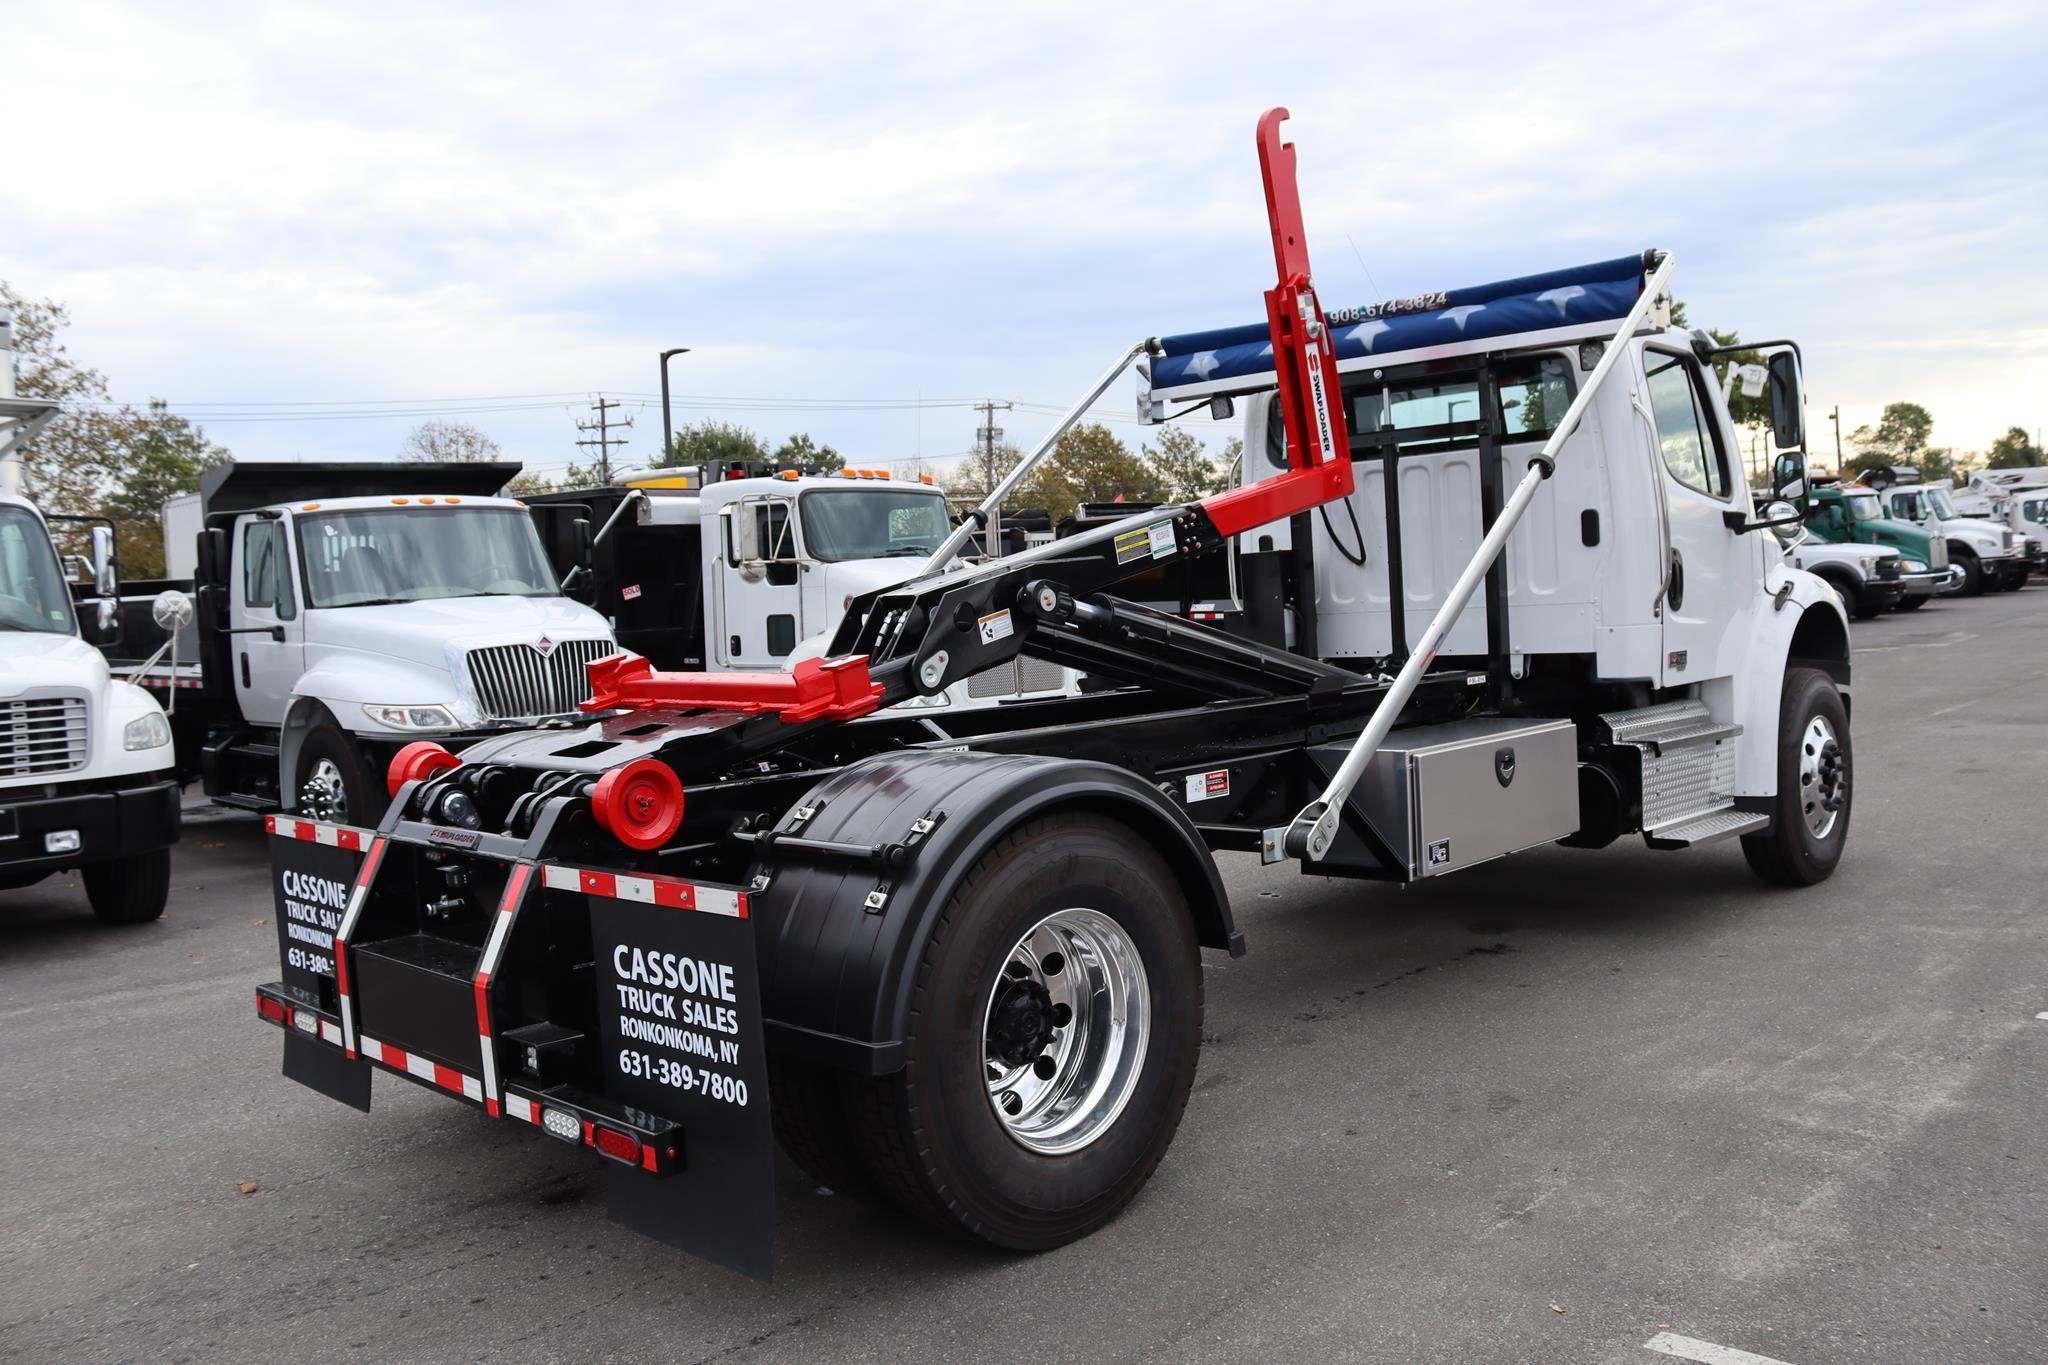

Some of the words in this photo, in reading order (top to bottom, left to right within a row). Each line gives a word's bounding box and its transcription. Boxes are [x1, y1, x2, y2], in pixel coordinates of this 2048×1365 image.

[1330, 291, 1447, 324] 908-674-3824
[1313, 375, 1330, 451] SWAPLOADER
[282, 870, 347, 909] CASSONE
[285, 899, 318, 925] TRUCK
[613, 944, 737, 1003] CASSONE
[616, 984, 677, 1020] TRUCK
[682, 999, 739, 1035] SALES
[620, 1015, 719, 1063] RONKONKOMA,
[719, 1040, 739, 1065] NY
[619, 1049, 748, 1107] 631-389-7800
